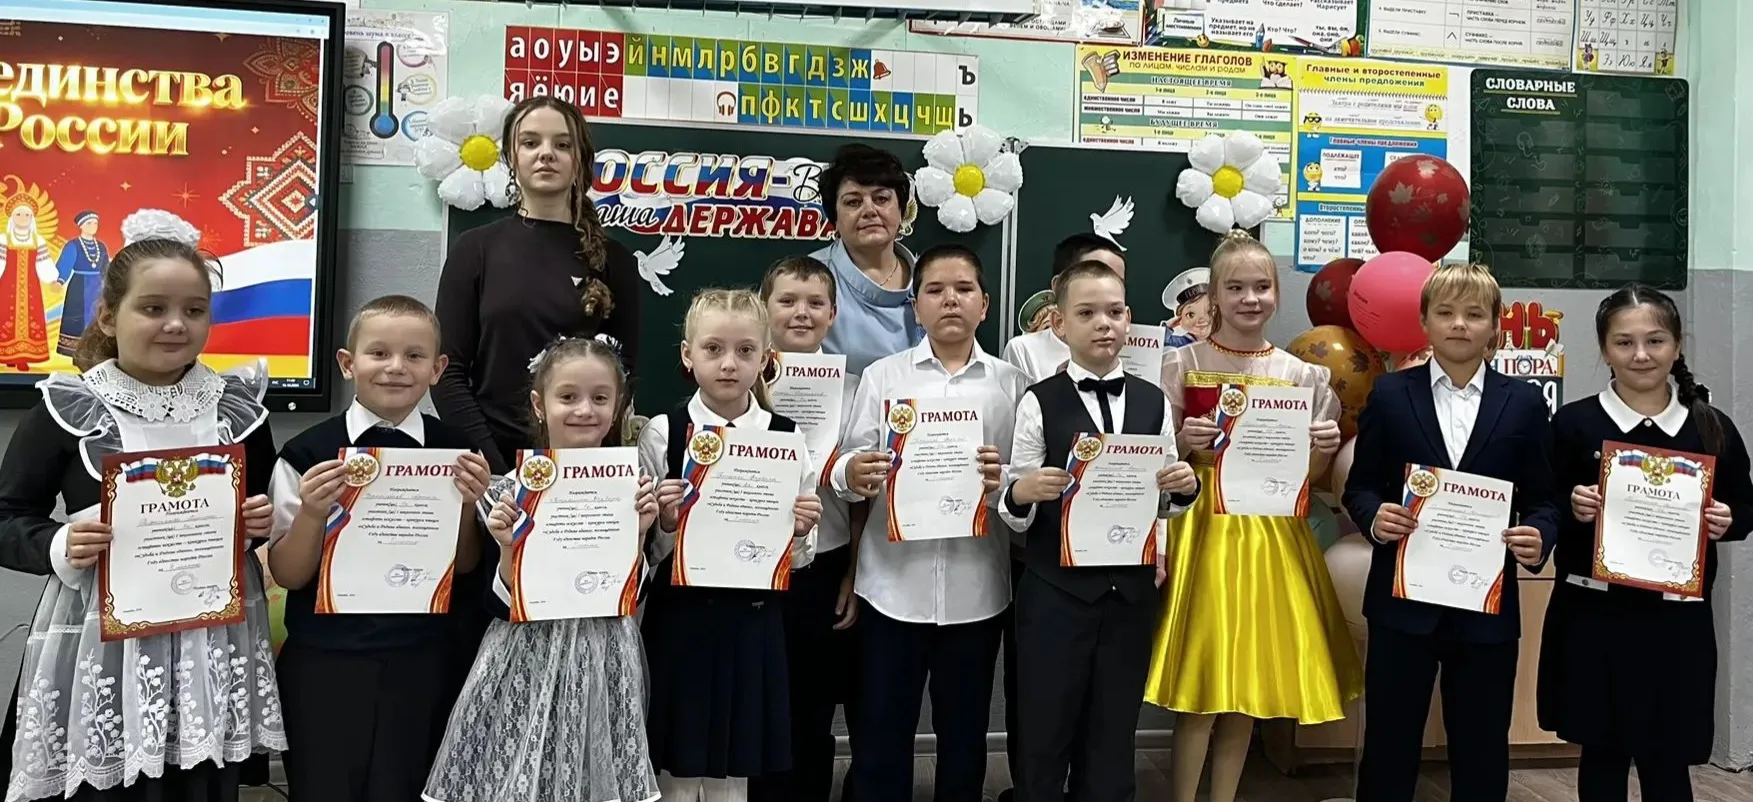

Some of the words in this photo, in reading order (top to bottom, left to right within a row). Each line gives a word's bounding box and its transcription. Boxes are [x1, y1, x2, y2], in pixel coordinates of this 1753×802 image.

[1211, 17, 1245, 25] Указывает
[510, 37, 525, 58] а
[534, 38, 549, 59] о
[558, 39, 573, 68] у
[579, 40, 599, 62] ы
[606, 42, 620, 64] э
[628, 37, 643, 65] й
[652, 46, 667, 66] н
[672, 48, 692, 68] м
[697, 48, 713, 69] л
[720, 49, 735, 77] р
[742, 45, 757, 73] б
[764, 53, 779, 73] в
[789, 54, 799, 74] г
[808, 56, 825, 81] д
[832, 57, 844, 77] з
[851, 59, 869, 79] ж
[958, 65, 976, 85] ъ
[1123, 50, 1191, 64] ИЗМЕНЕНИЕ
[1194, 54, 1253, 66] ГЛАГОЛОВ
[1306, 64, 1350, 74] Главные
[1362, 67, 1441, 79] второстепенные
[0, 61, 246, 110] единства
[1151, 76, 1202, 86] НАСТОЯЩЕЕ
[1203, 78, 1232, 87] ВРЕМЯ
[1324, 75, 1356, 83] члены
[1359, 77, 1425, 87] предложения
[1485, 77, 1576, 93] СЛОВАРНЫЕ
[510, 82, 525, 103] я
[554, 84, 574, 104] ю
[580, 86, 595, 107] и
[604, 87, 619, 108] е
[741, 95, 755, 115] п
[761, 90, 780, 124] ф
[786, 98, 799, 118] к
[809, 99, 821, 119] т
[832, 101, 843, 120] с
[850, 102, 868, 122] ш
[874, 103, 887, 123] х
[894, 104, 909, 129] ц
[917, 105, 930, 125] ч
[935, 106, 953, 131] щ
[959, 108, 972, 127] ь
[1506, 96, 1556, 110] СЛОВА
[1149, 119, 1188, 128] БУДУЩЕЕ
[1189, 120, 1219, 128] ВРЕМЯ
[591, 151, 790, 200] ОССИЯ-
[596, 204, 659, 227] аша
[1124, 336, 1159, 349] МОТА
[786, 366, 841, 378] ГРАМОТА
[1252, 398, 1308, 411] ГРАМОТА
[921, 410, 978, 423] ГРАМОТА
[728, 443, 798, 461] ГРАМОТА
[1106, 444, 1163, 455] ГРАМОТА
[563, 464, 635, 479] ГРАМОТА
[1443, 482, 1507, 502] ГРАМОТА
[1627, 483, 1681, 500] ГРАМОТА
[140, 498, 210, 515] ГРАМОТА
